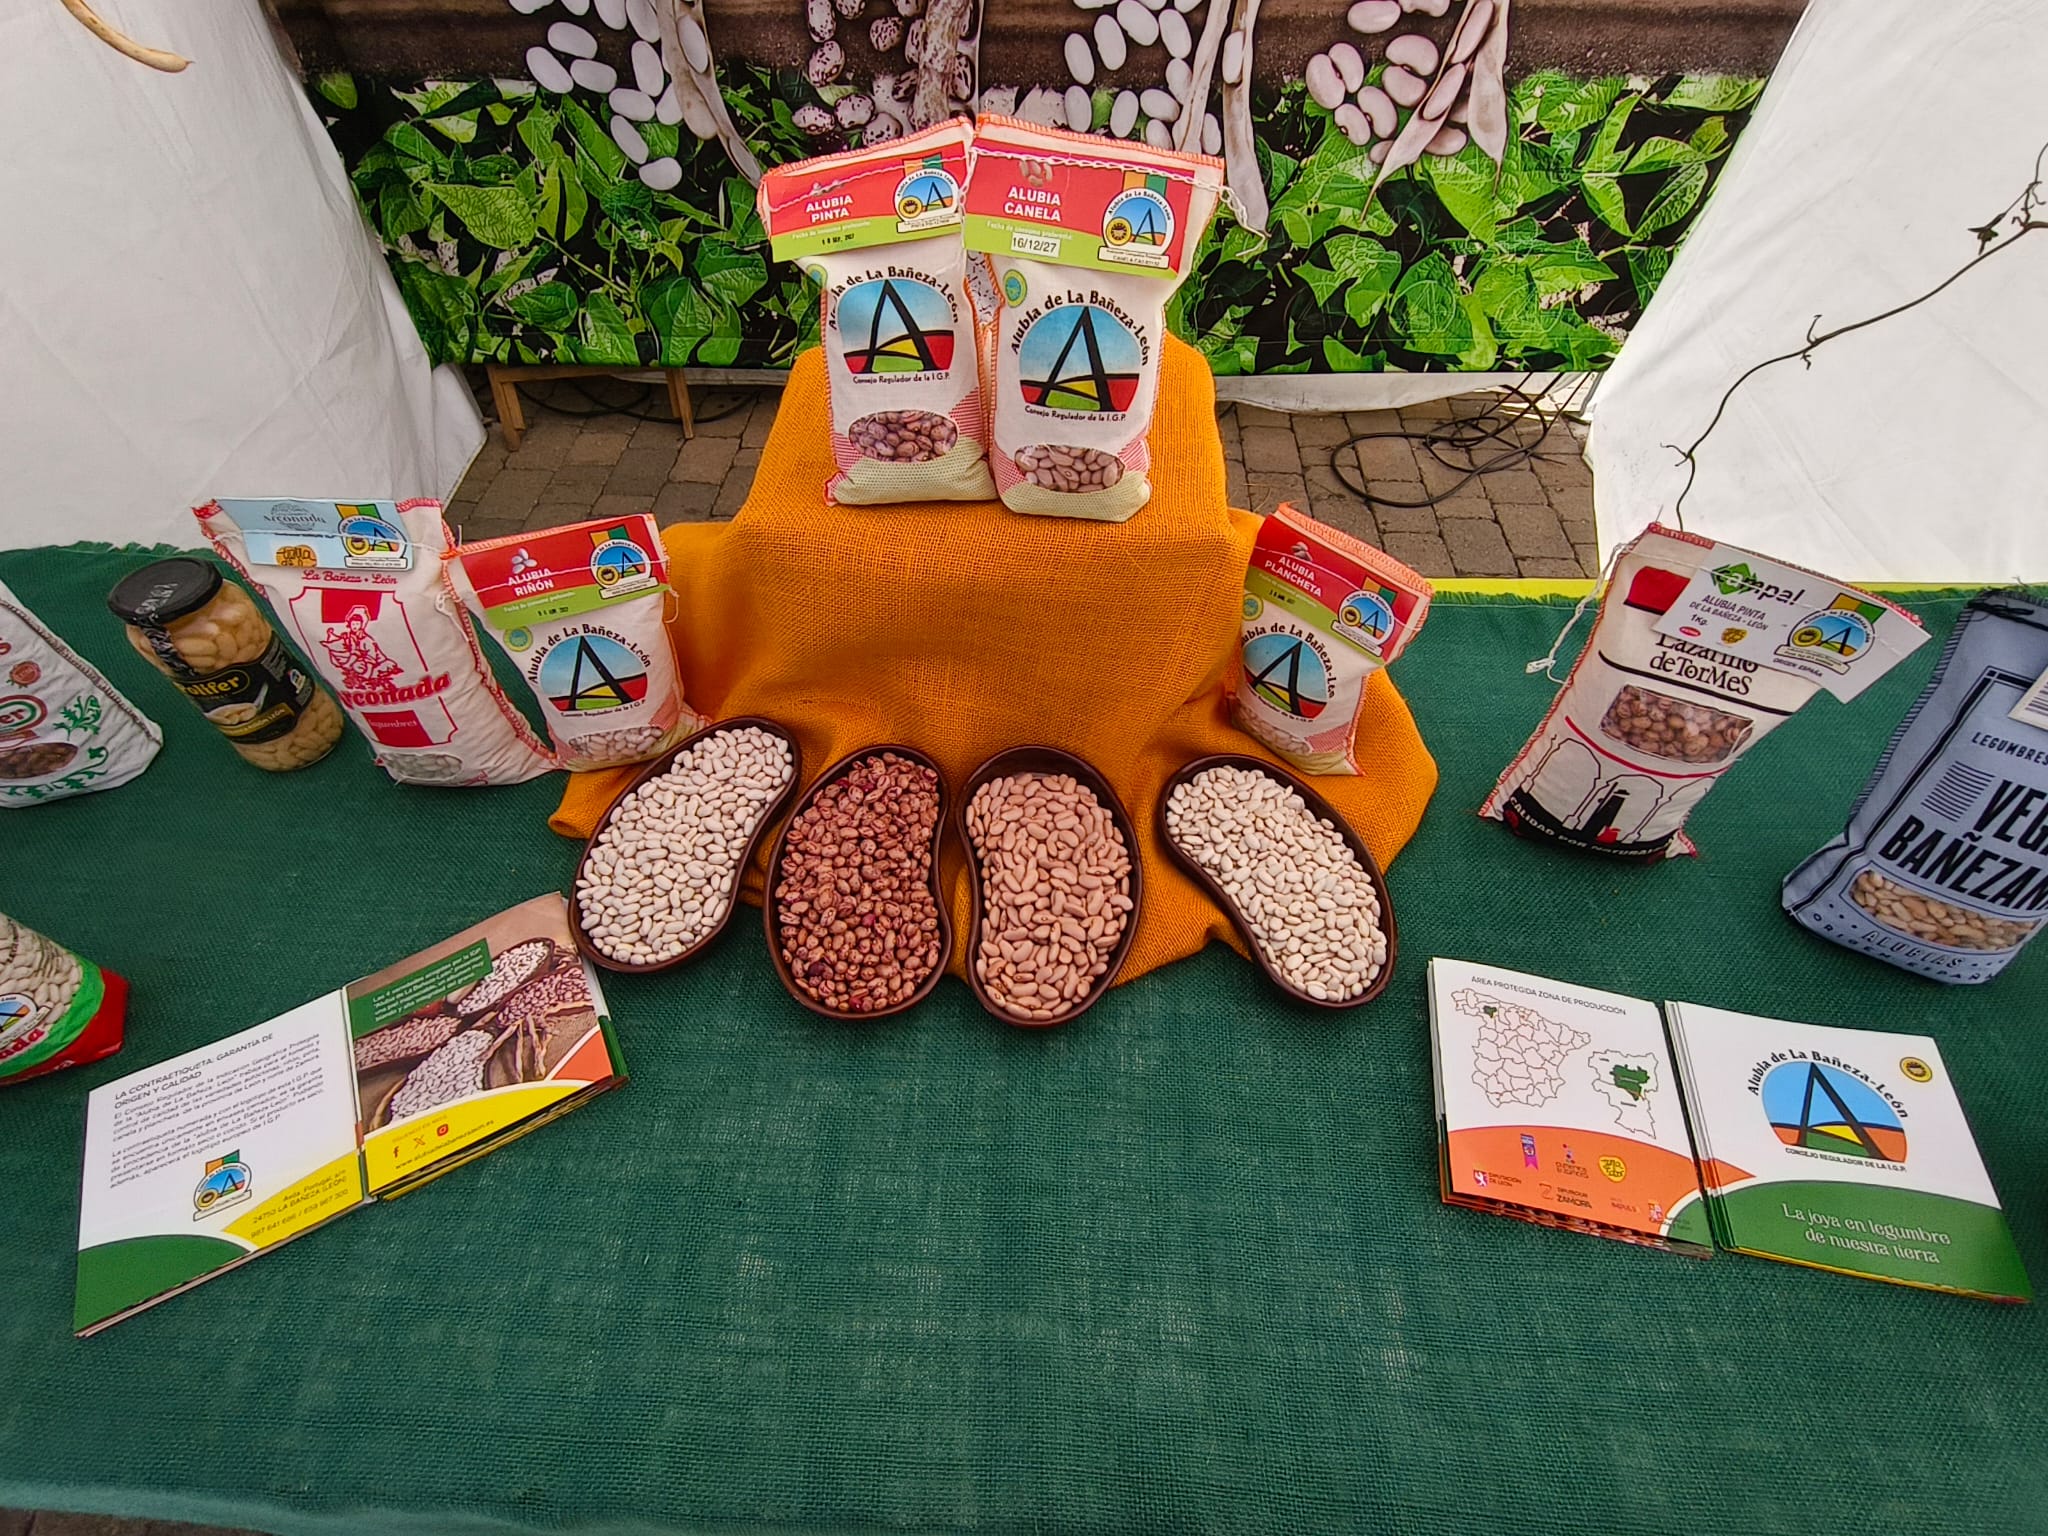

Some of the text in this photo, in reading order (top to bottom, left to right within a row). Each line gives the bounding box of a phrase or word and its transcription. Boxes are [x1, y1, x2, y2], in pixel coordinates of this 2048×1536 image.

[806, 195, 853, 213] ALUBIA
[1008, 186, 1061, 206] ALUBIA
[811, 208, 850, 224] PINTA
[1004, 202, 1062, 223] CANELA
[1012, 236, 1057, 253] 16/12/27
[846, 275, 863, 287] de
[866, 269, 884, 281] La
[888, 266, 959, 324] Bañeza-León
[1044, 295, 1063, 310] de
[1067, 289, 1084, 304] La
[1089, 290, 1150, 366] Bañeza-León
[853, 376, 877, 384] Consejo
[879, 375, 911, 385] Regulador
[1024, 405, 1050, 418] Consejo
[1051, 410, 1086, 421] Regulador
[1088, 413, 1096, 421] de
[1099, 414, 1105, 422] la
[302, 569, 398, 585] La Bañeza León
[508, 568, 552, 587] ALUBIA
[1264, 559, 1324, 598] PLANCHETA
[1278, 556, 1315, 582] ALUBIA
[514, 578, 554, 598] RIÑÓN
[1689, 601, 1769, 631] DE LA BAÑEZA LEÓN
[1702, 594, 1766, 621] ALUBIA PINTA
[1270, 622, 1286, 634] de
[1288, 623, 1303, 638] La
[548, 632, 562, 647] de
[563, 627, 579, 638] La
[582, 623, 652, 668] Bañeza-León
[1972, 732, 2048, 766] LEGUMBRES
[1510, 796, 1556, 837] CALIDAD
[1558, 835, 1588, 848] POR
[1973, 778, 2048, 856] VEG
[1878, 814, 2048, 911] BAÑEZAN
[1813, 913, 1891, 958] ORIGEN
[1862, 930, 1963, 968] ALUBIAS
[1494, 980, 1537, 996] PROTEGIDA
[1538, 990, 1560, 1002] ZONA
[1562, 995, 1573, 1004] DE
[114, 1090, 150, 1108] ORIGEN
[161, 1070, 202, 1091] CALIDAD
[115, 1091, 126, 1099] LA
[1747, 1049, 1908, 1119] Alubia de La Bañeza-León
[1786, 1147, 1819, 1160] CONSEJO
[1820, 1152, 1864, 1166] REGULADOR
[1865, 1160, 1876, 1168] DE
[1876, 1162, 1886, 1170] LA
[278, 1204, 288, 1213] LA
[290, 1189, 320, 1208] BAÑEZA
[1782, 1203, 1951, 1245] La joya en legumbre
[1805, 1228, 1940, 1264] de nuestra tierra
